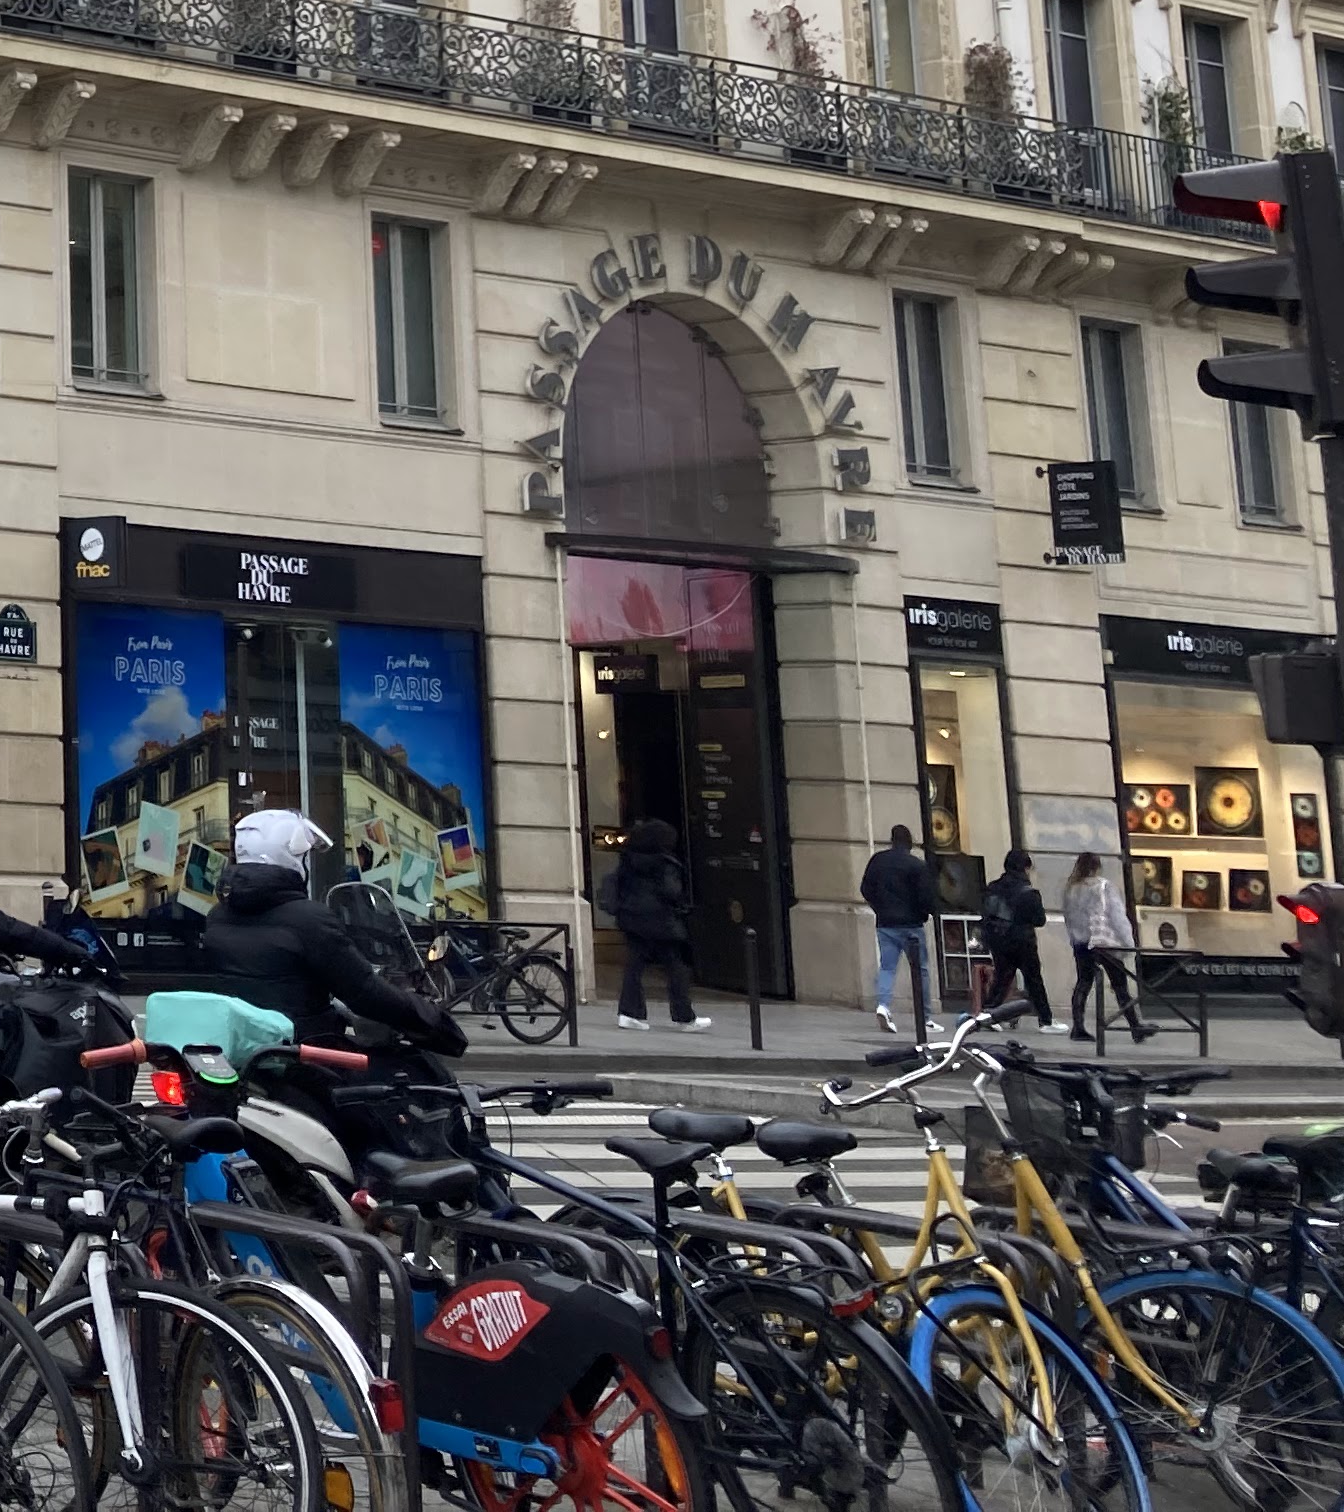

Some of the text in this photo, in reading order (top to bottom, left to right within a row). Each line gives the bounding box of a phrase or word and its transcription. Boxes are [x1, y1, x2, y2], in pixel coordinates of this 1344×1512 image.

[515, 233, 877, 543] PASSAGE DU HAVRE
[76, 561, 110, 578] fnac
[240, 553, 308, 576] PASSAGE
[250, 568, 274, 587] DU
[237, 582, 291, 604] HAVRE
[3, 626, 24, 638] RUE
[115, 656, 185, 686] PARIS
[374, 674, 443, 703] PARIS
[442, 1291, 527, 1351] ESSAI GRATUIT
